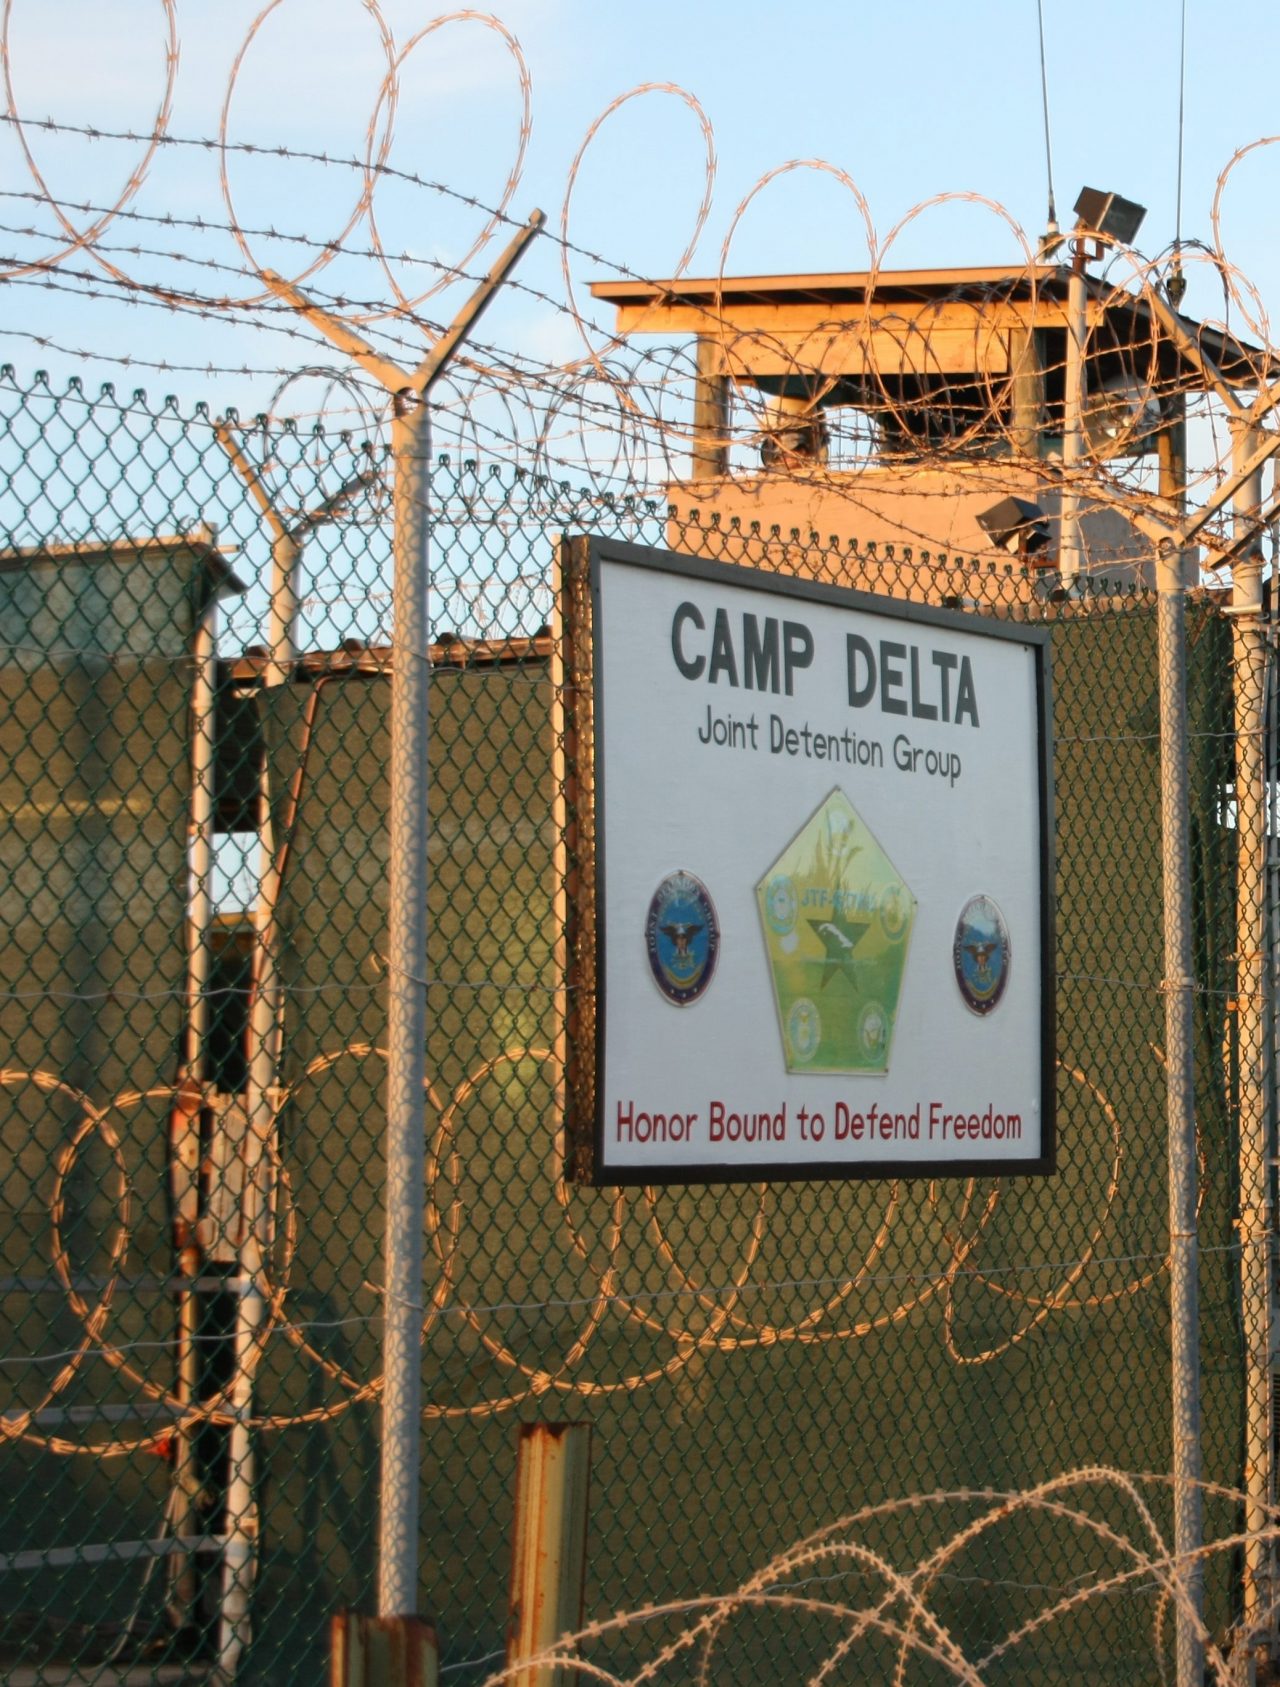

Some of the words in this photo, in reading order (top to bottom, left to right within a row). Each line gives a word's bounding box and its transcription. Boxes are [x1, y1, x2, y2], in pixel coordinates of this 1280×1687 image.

[672, 601, 815, 697] CAMP
[846, 633, 980, 728] DELTA
[698, 705, 759, 750] Joint
[770, 714, 884, 768] Detention
[894, 734, 962, 788] Group
[616, 1101, 698, 1142] Honor
[709, 1101, 786, 1142] Bound
[797, 1105, 825, 1142] to
[835, 1101, 920, 1140] Defend
[929, 1102, 1022, 1140] Freedom
